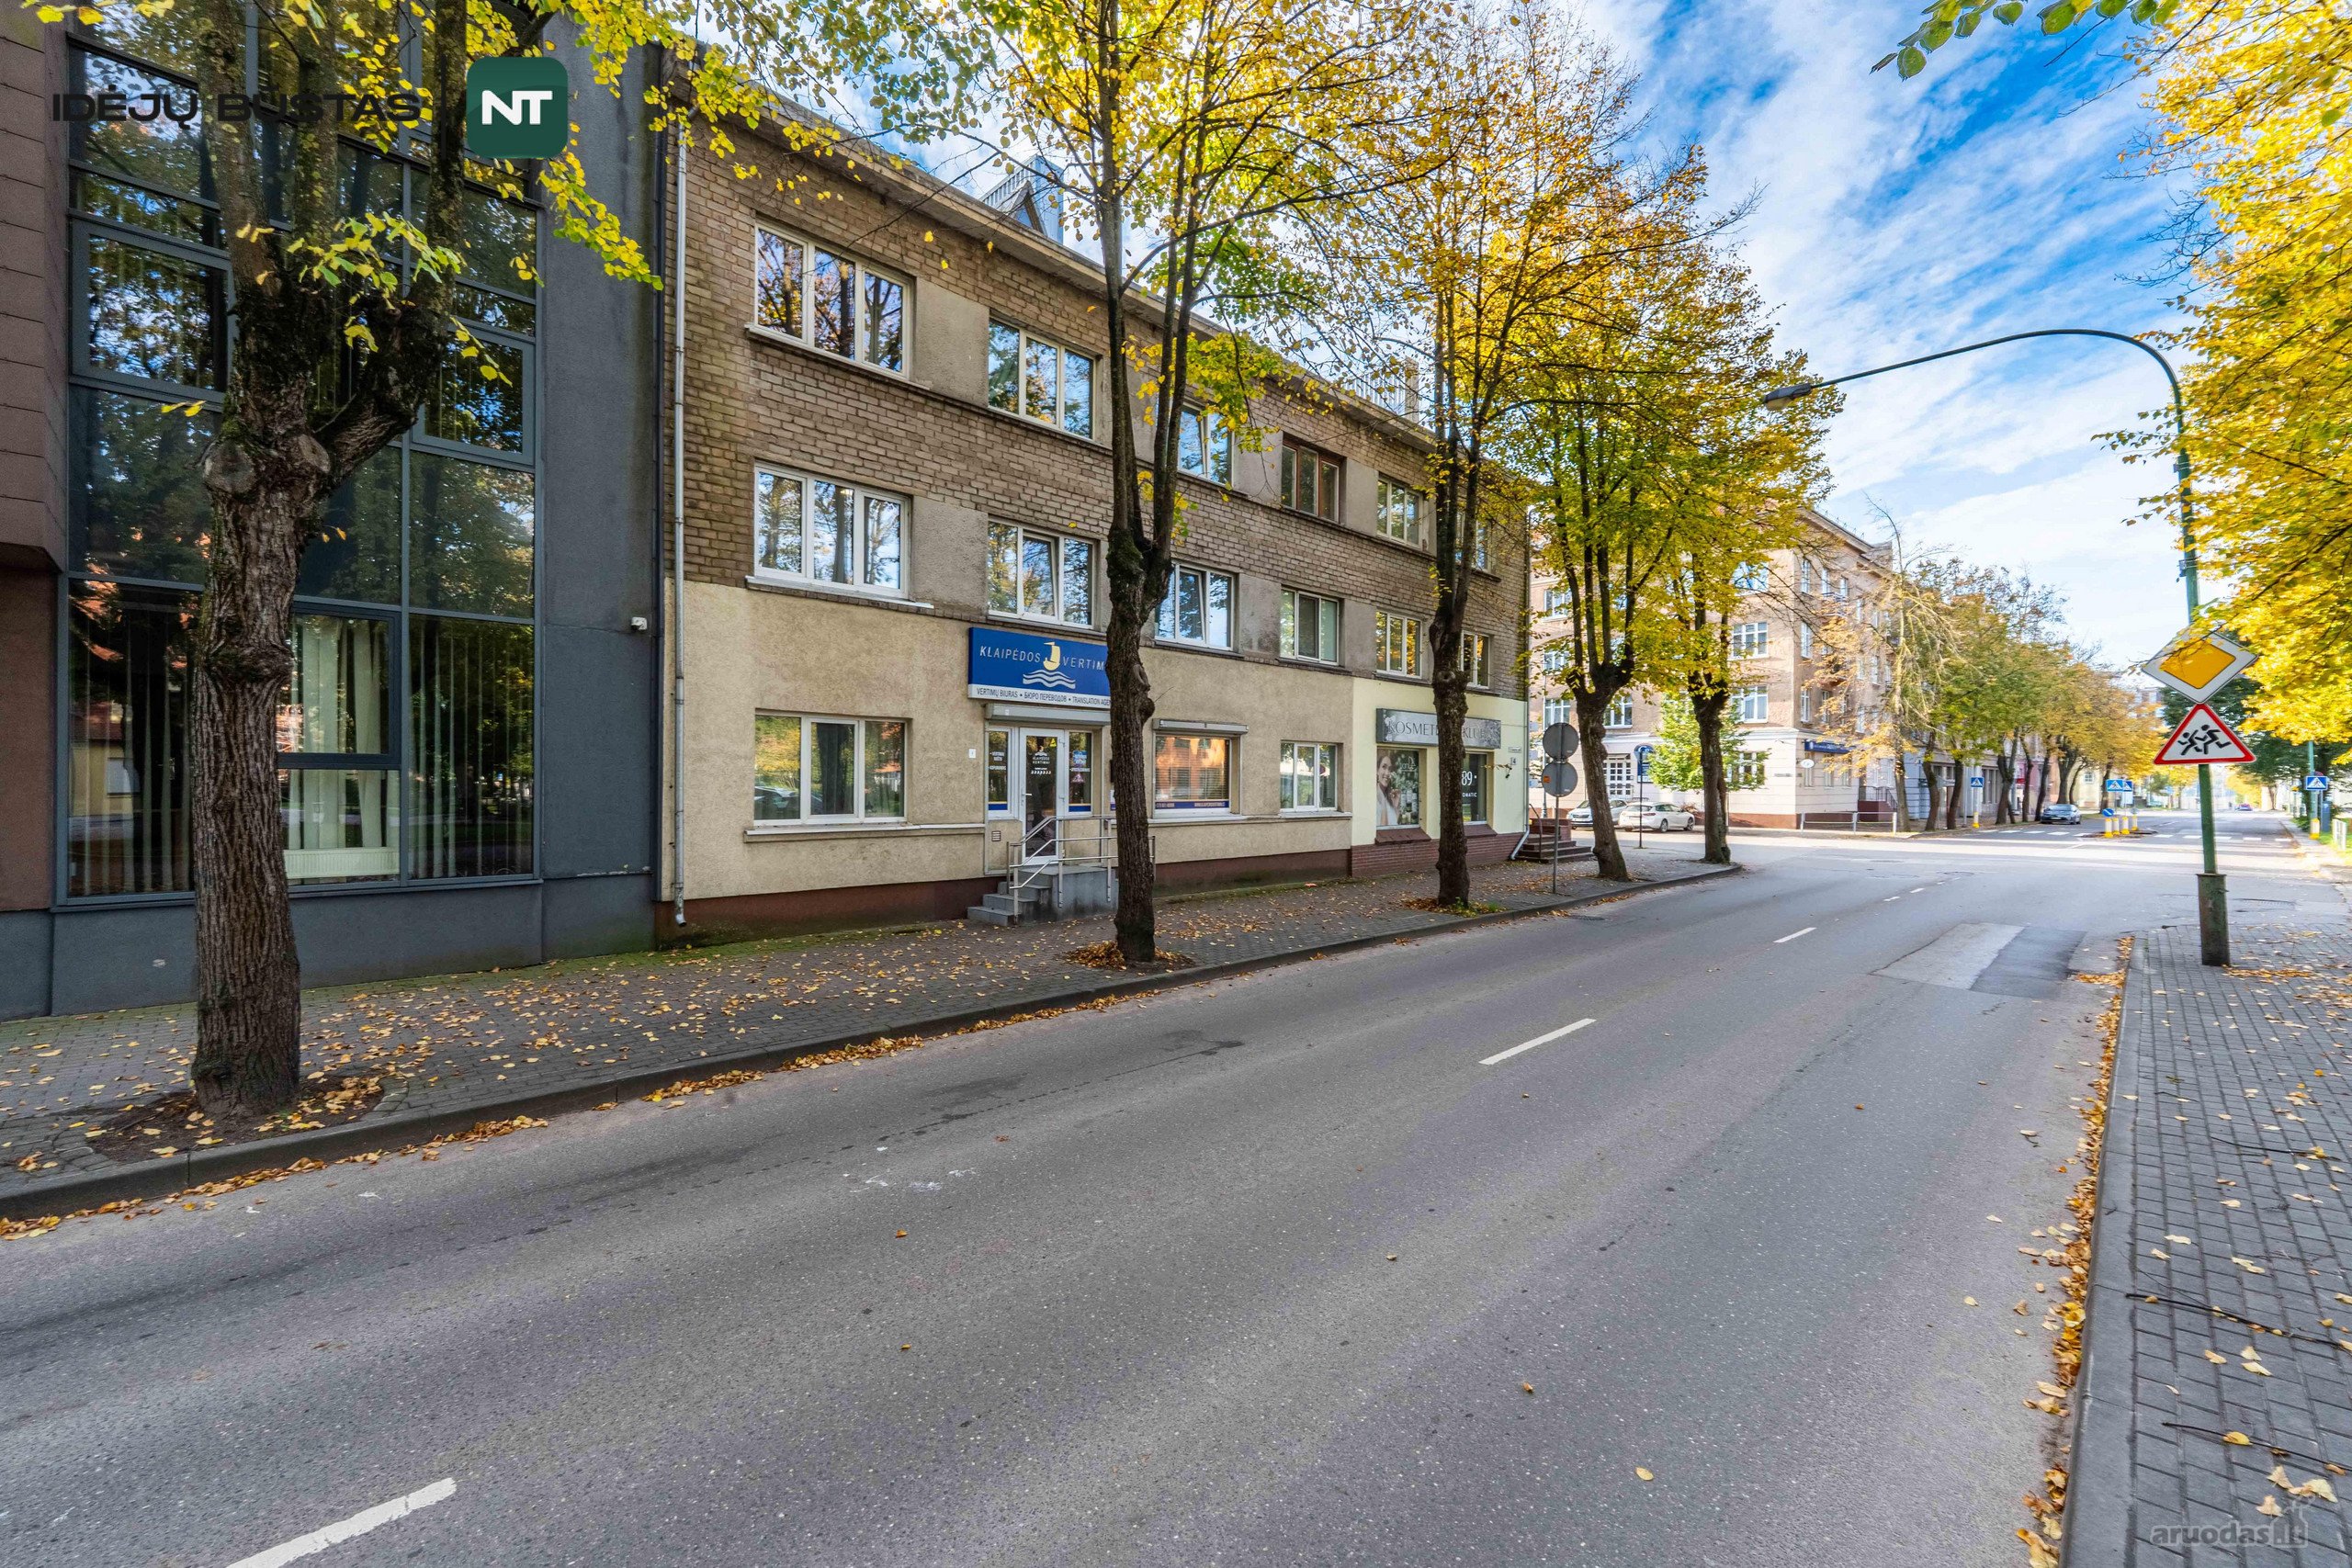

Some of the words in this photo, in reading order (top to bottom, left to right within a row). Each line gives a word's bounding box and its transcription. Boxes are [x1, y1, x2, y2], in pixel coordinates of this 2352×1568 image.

[979, 645, 1041, 663] KLAIPĖDOS
[1062, 656, 1104, 671] VERTIM
[977, 687, 999, 698] VERTIMŲ
[1000, 690, 1018, 699] BIURAS
[1023, 692, 1039, 700] БЮРО
[1039, 694, 1068, 703] ПЕРЕВОДОВ
[1072, 696, 1101, 705] TRANSLATION
[1387, 720, 1440, 736] KOSMETI
[1461, 770, 1473, 786] 89
